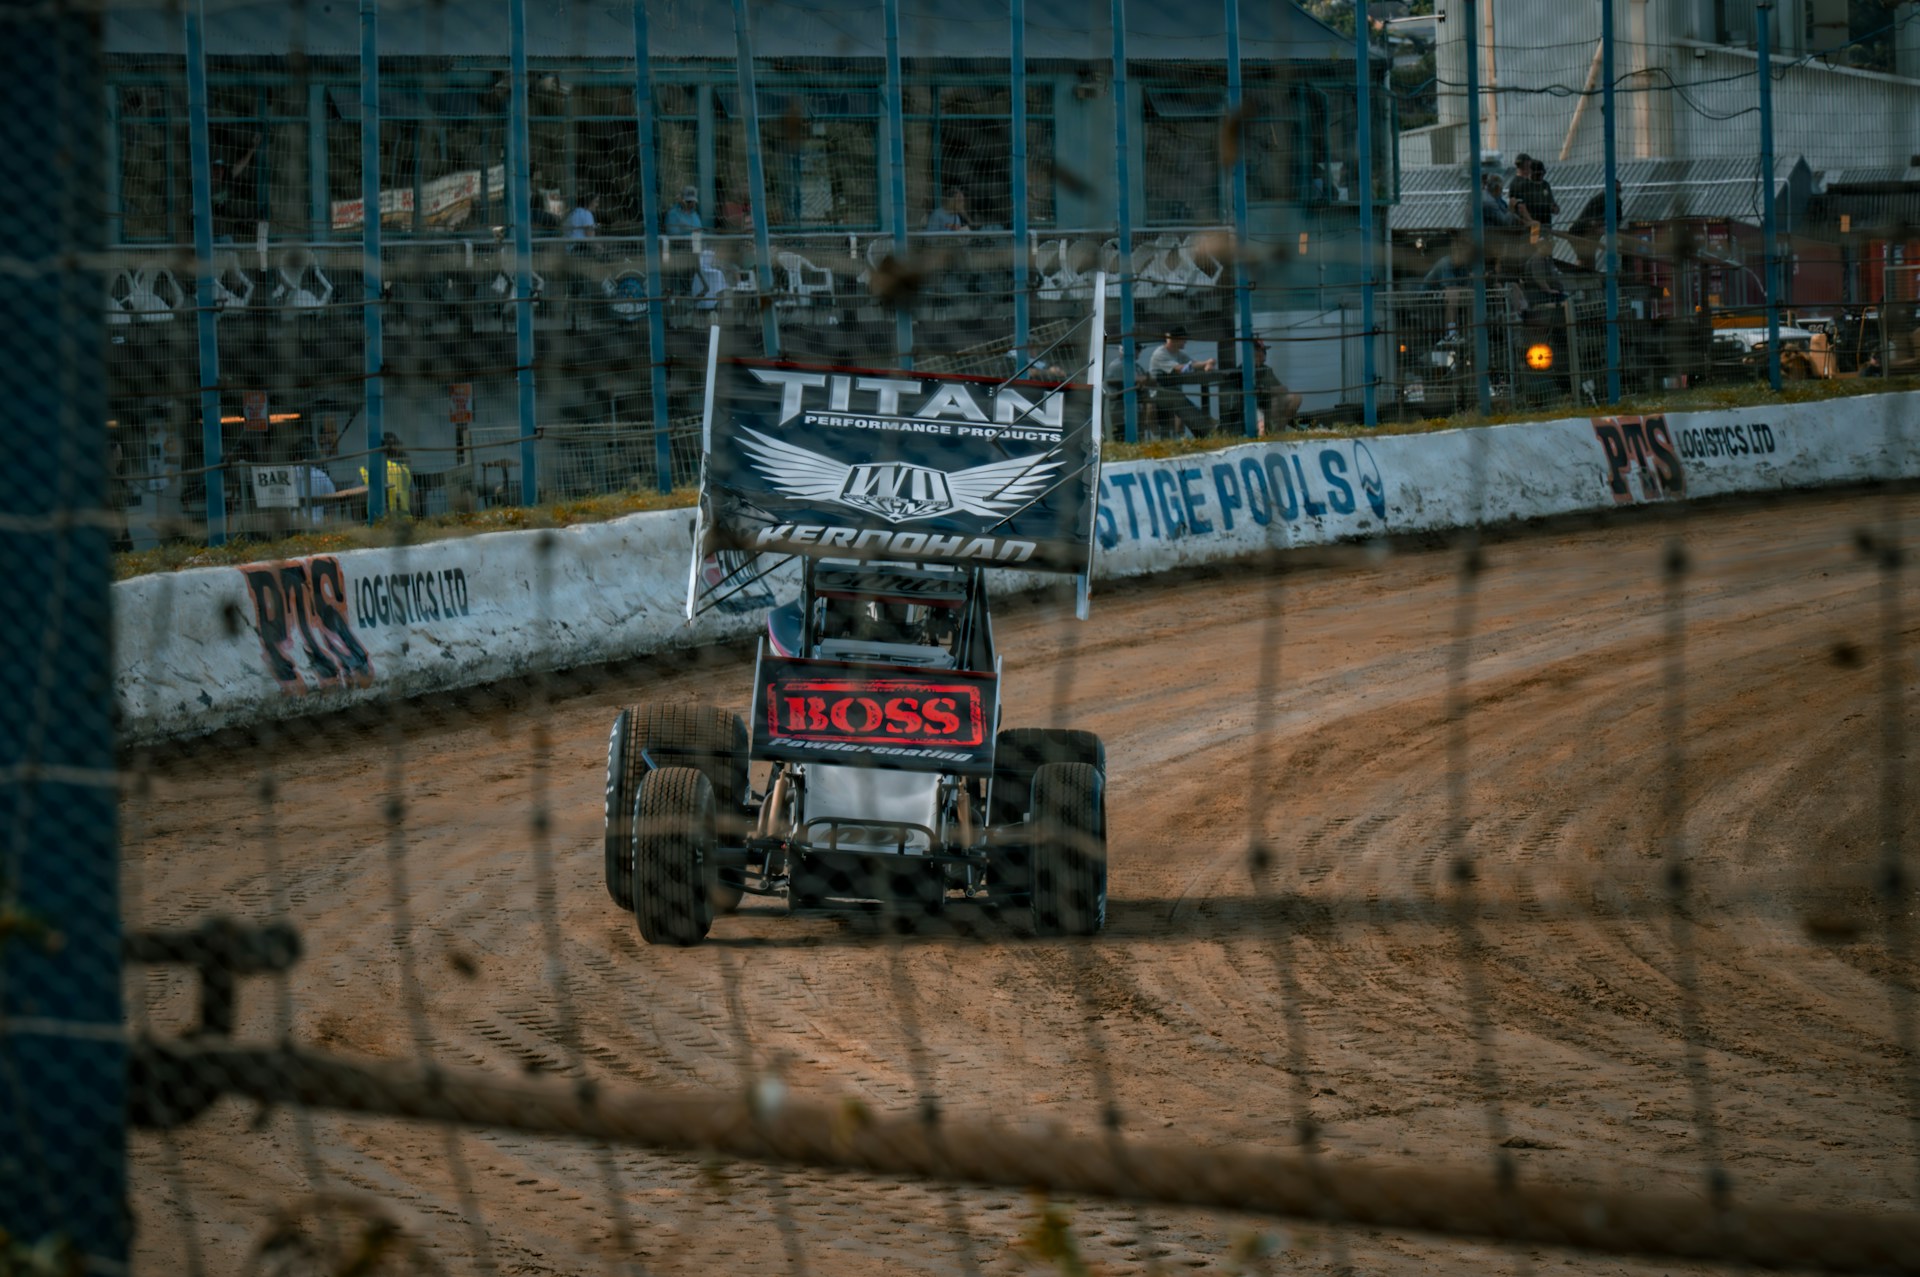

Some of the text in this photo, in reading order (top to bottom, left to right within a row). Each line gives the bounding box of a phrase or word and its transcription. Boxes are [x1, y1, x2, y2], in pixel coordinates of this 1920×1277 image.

[748, 369, 1064, 427] TITAN
[804, 415, 1062, 443] PERFORMANCE PRODUCTS
[1594, 416, 1776, 497] PTS LOGISTICS LTD
[257, 470, 292, 488] BAR
[1212, 449, 1356, 531] POOLS
[755, 524, 1037, 562] KERNOHAN
[245, 556, 469, 684] PTS LOGISTICS LTD
[783, 696, 960, 735] BOSS
[768, 737, 974, 763] Powdercoating
